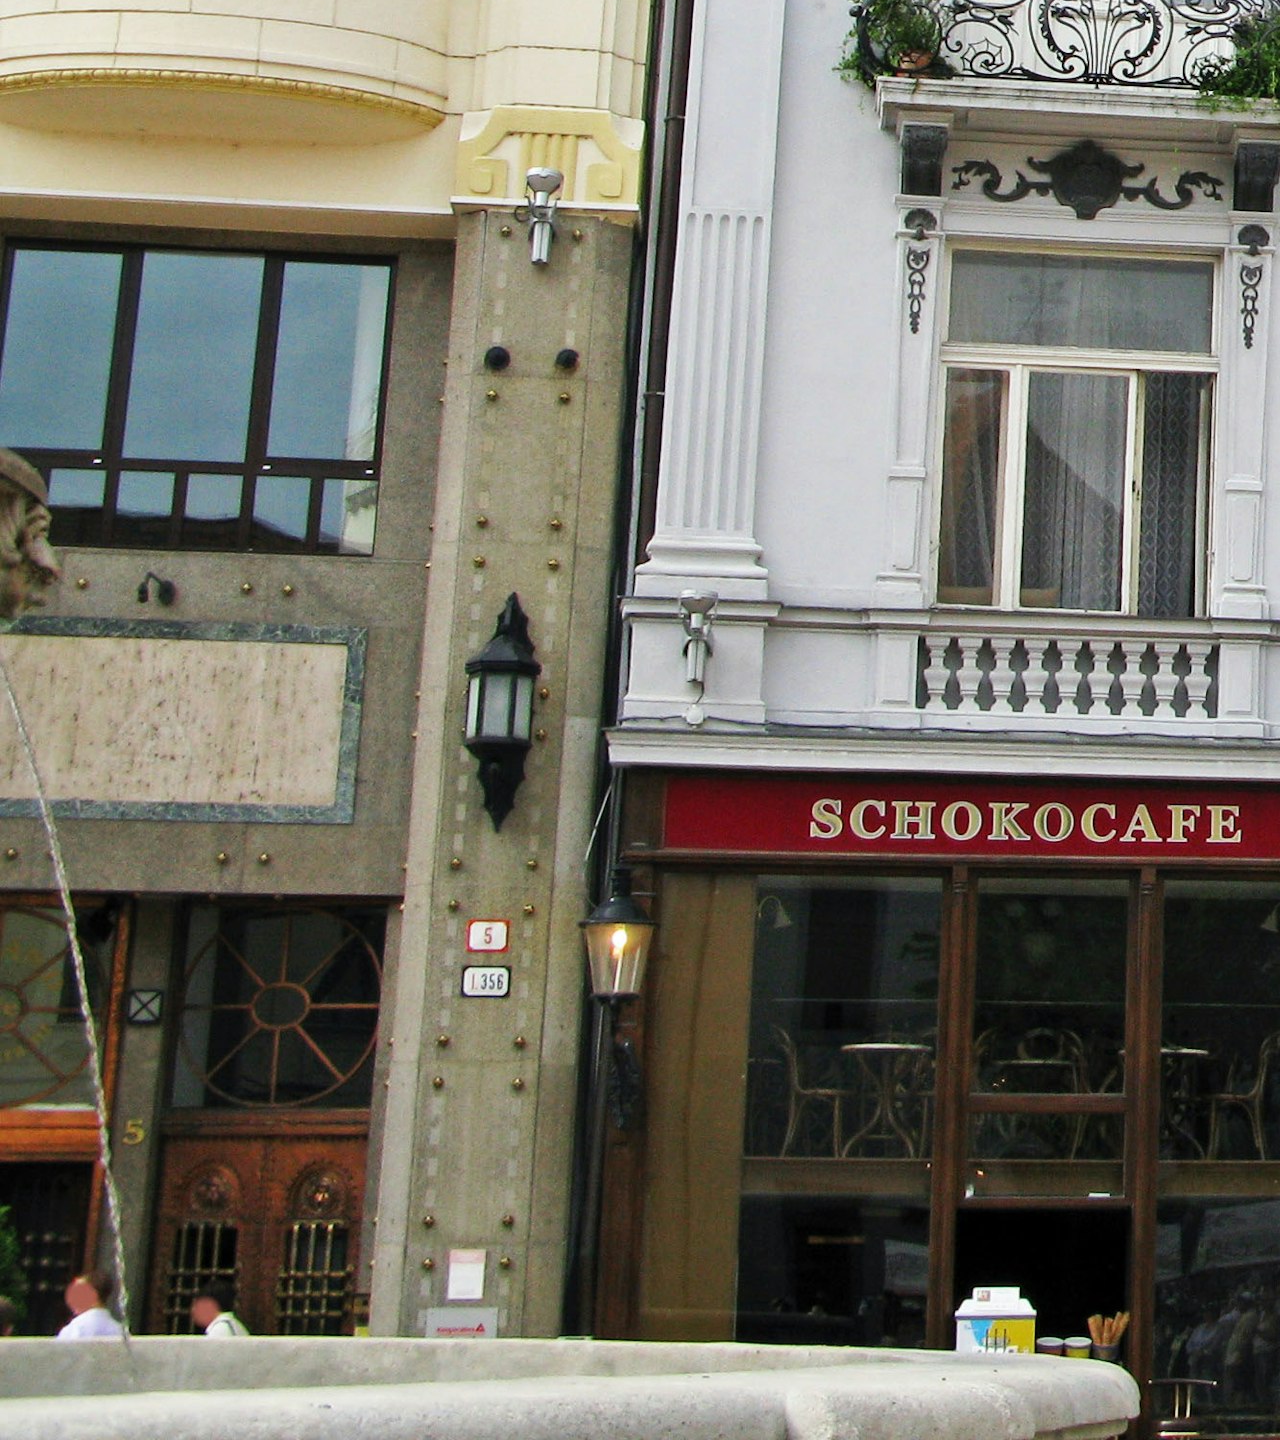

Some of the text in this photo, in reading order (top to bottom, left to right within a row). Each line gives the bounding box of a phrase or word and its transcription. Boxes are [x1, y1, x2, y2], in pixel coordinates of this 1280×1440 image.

[809, 798, 1242, 843] SCHOKOCAFE
[484, 926, 493, 945] 5
[122, 1119, 145, 1146] 5
